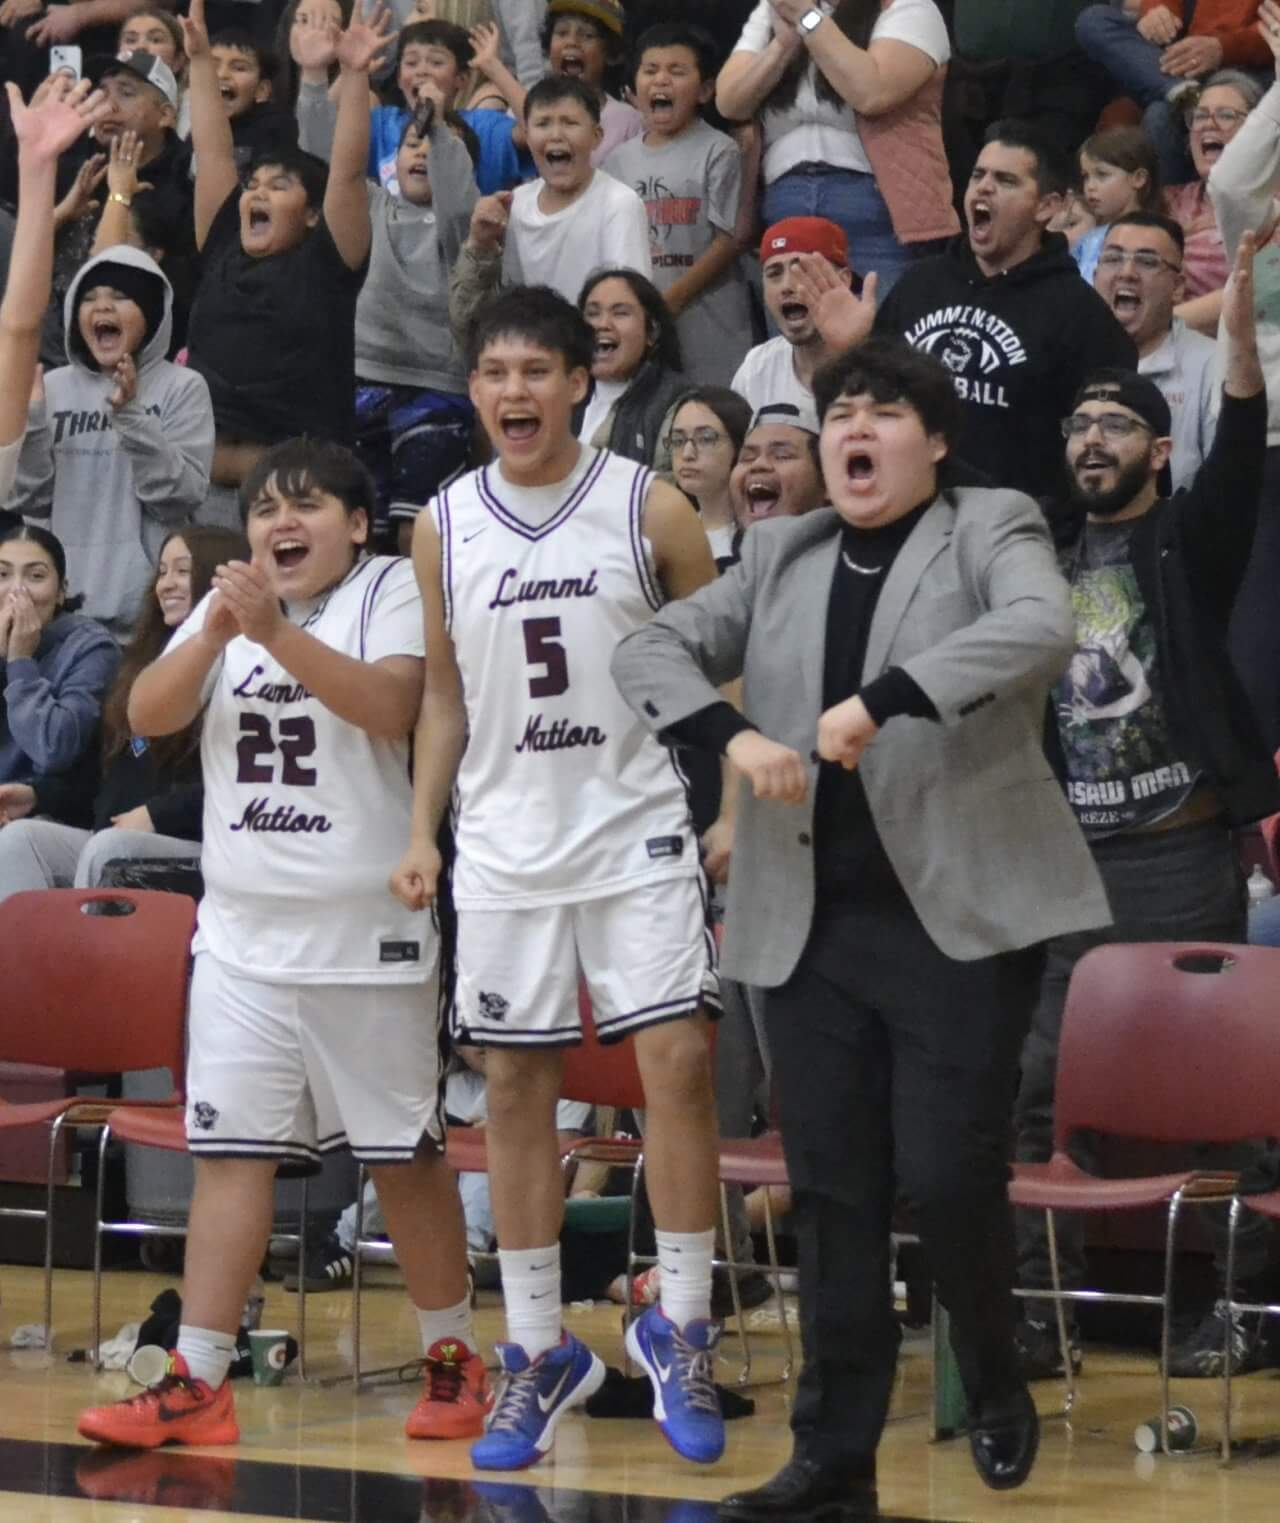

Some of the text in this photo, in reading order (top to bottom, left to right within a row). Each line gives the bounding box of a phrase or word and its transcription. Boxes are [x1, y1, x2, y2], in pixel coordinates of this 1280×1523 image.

[651, 255, 694, 268] PIONS
[904, 305, 1028, 366] LUMMI NATION
[955, 376, 1009, 408] BALL
[52, 410, 112, 445] THRA
[489, 568, 598, 610] Lummi
[522, 616, 570, 699] 5
[233, 665, 312, 703] Lumm
[236, 712, 317, 787] 22
[515, 713, 607, 753] Nation
[230, 797, 332, 833] Nation
